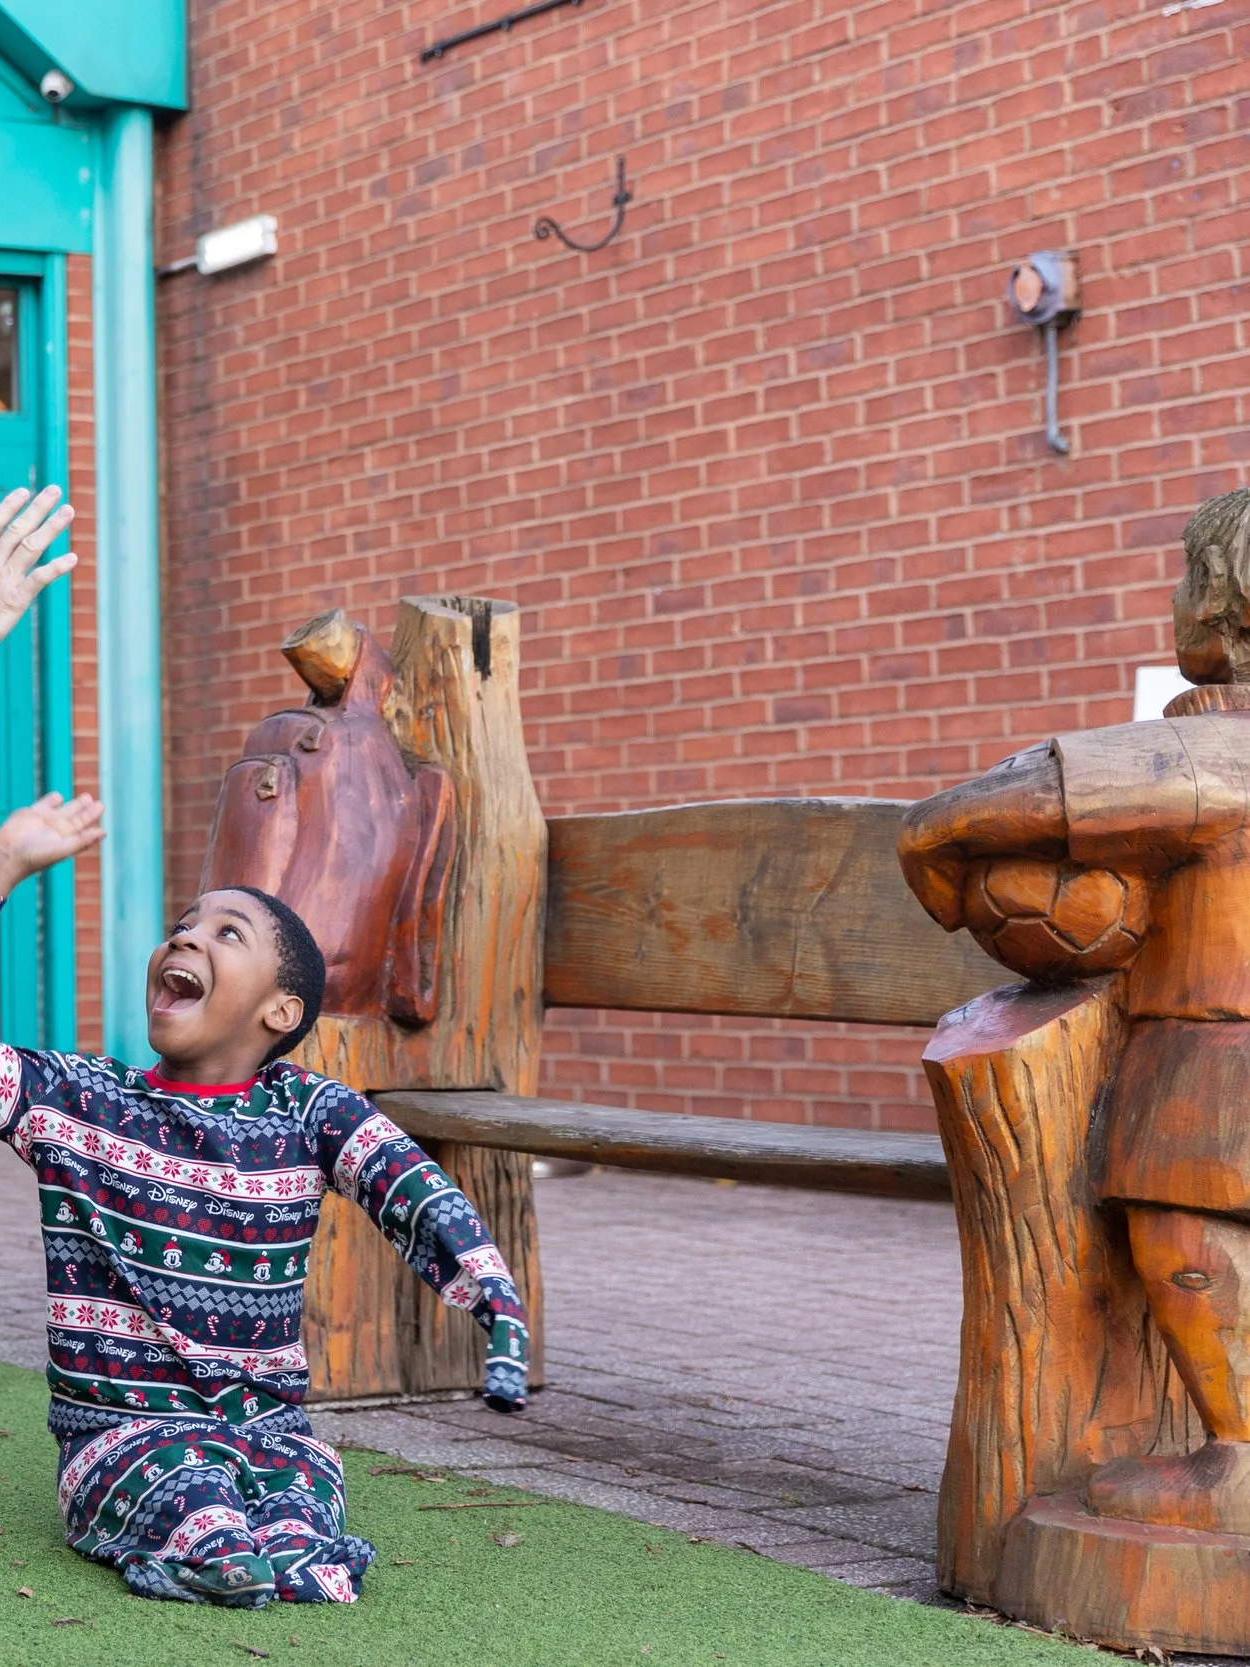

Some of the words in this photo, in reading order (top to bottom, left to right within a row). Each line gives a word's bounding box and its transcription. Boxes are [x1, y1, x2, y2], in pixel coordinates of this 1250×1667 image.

[44, 1144, 88, 1177] Disney
[358, 1156, 387, 1192] Disney
[98, 1164, 140, 1199] Disney
[147, 1181, 198, 1213] Disney
[204, 1195, 255, 1225] Disney
[264, 1205, 302, 1225] Disney
[48, 1327, 85, 1354] Disney
[94, 1334, 137, 1362] Disney
[189, 1360, 241, 1379] Disney
[73, 1471, 101, 1507] Disney
[100, 1436, 151, 1467] Disney
[154, 1420, 217, 1437] Disney
[258, 1429, 297, 1458] Disney
[303, 1445, 343, 1485] Disney
